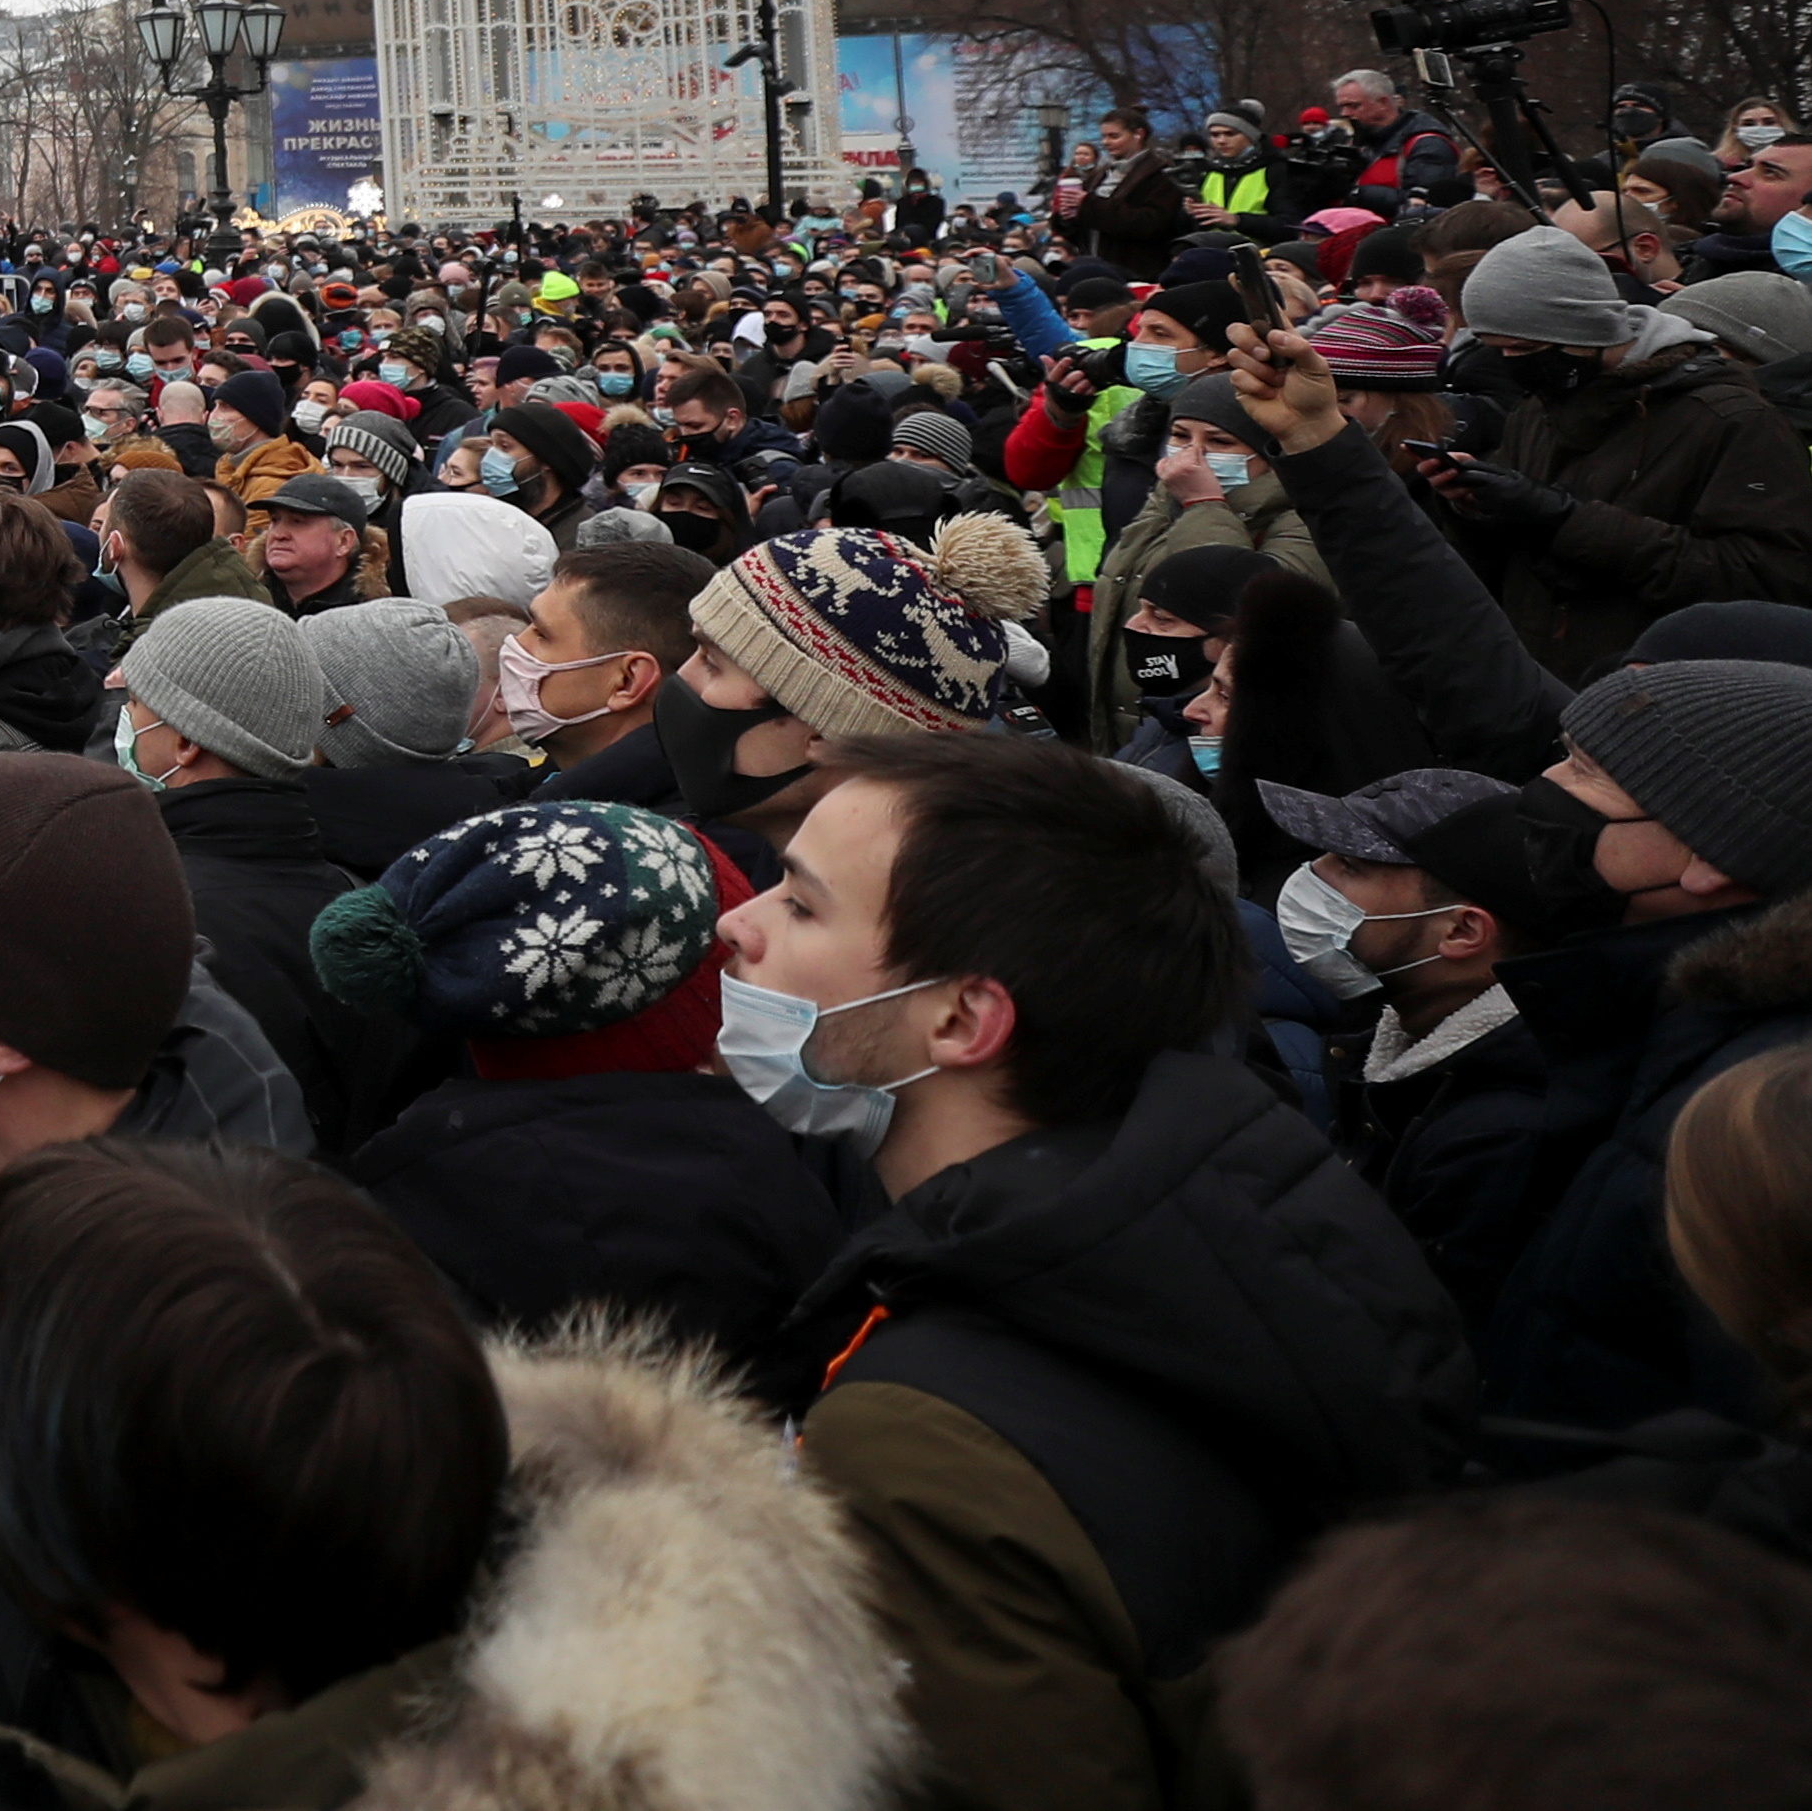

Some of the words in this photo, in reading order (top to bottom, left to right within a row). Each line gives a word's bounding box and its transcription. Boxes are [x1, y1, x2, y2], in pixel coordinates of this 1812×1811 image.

[308, 117, 382, 134] ЖИЗНЬ
[283, 135, 381, 152] ПРЕКРАС
[1137, 667, 1171, 679] COOL
